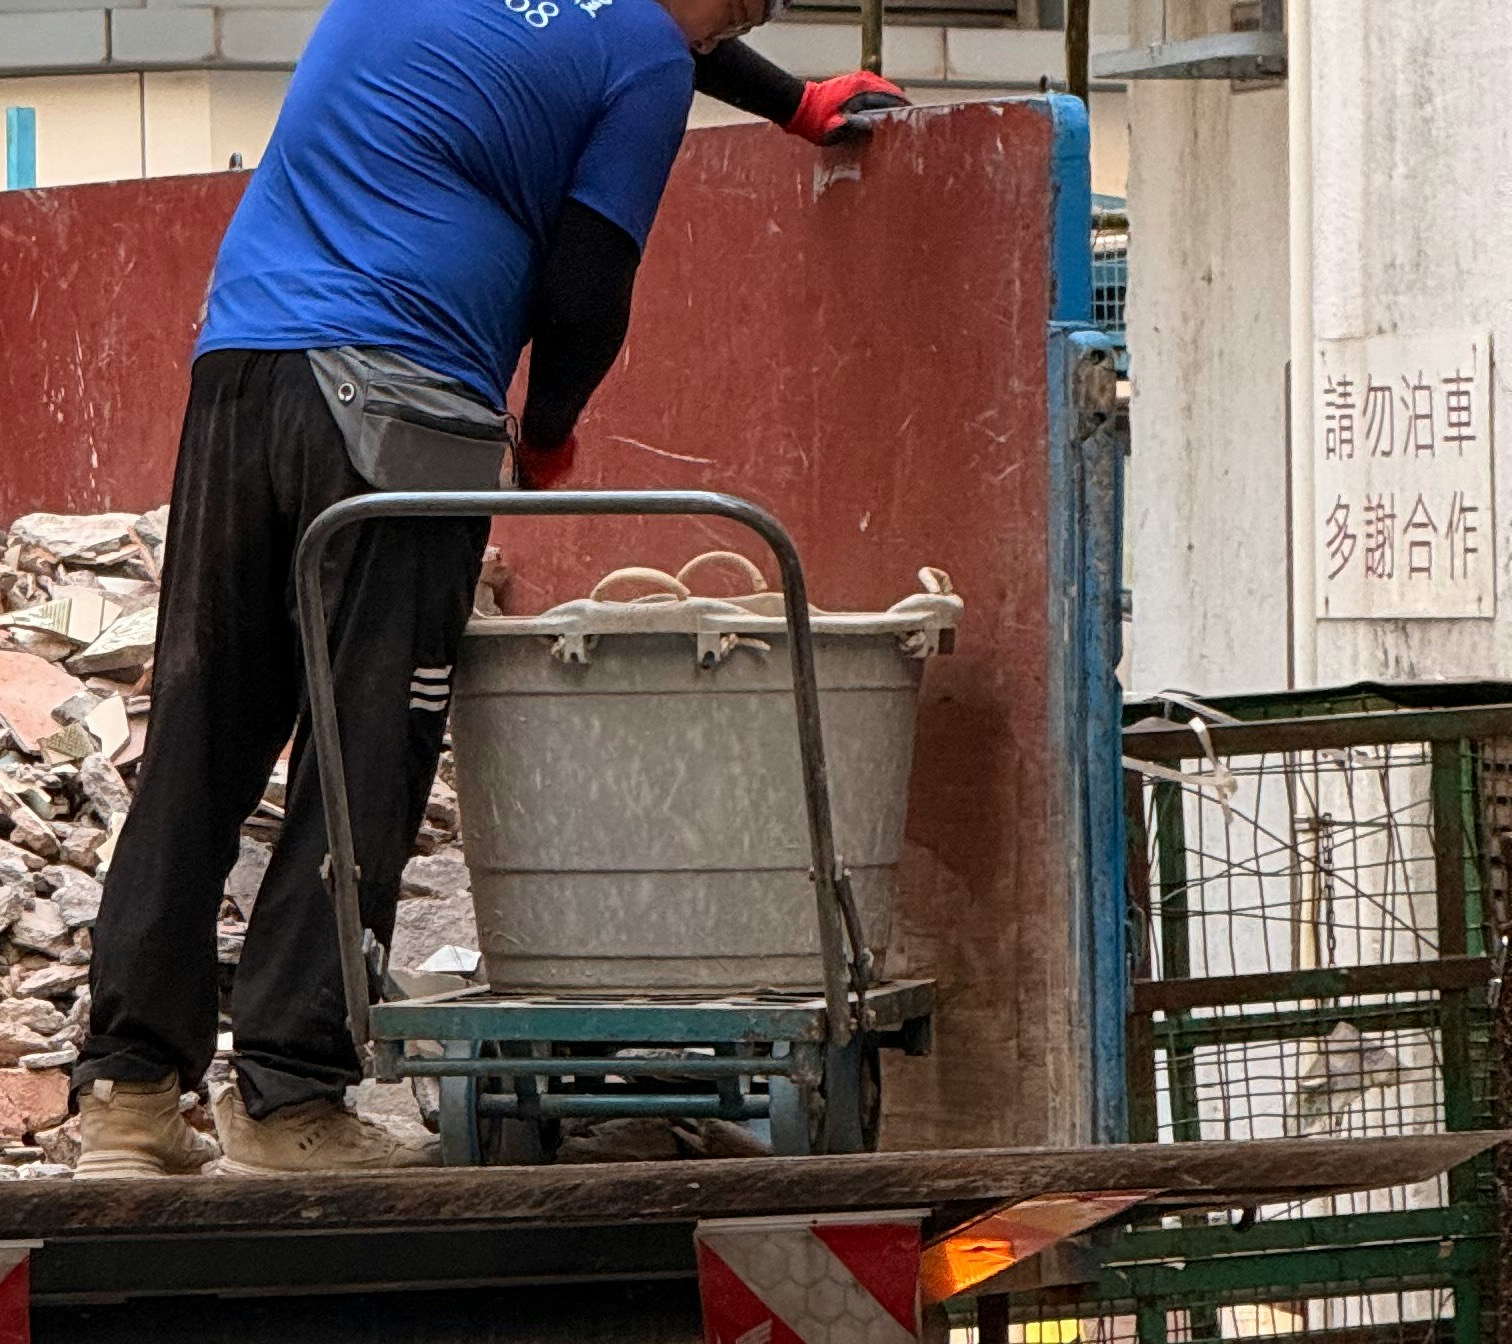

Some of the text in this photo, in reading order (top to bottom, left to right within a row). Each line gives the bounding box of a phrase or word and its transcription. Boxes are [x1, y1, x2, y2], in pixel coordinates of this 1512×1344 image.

[1323, 368, 1477, 461] 請勿泊車
[1325, 490, 1479, 581] 多謝合作
